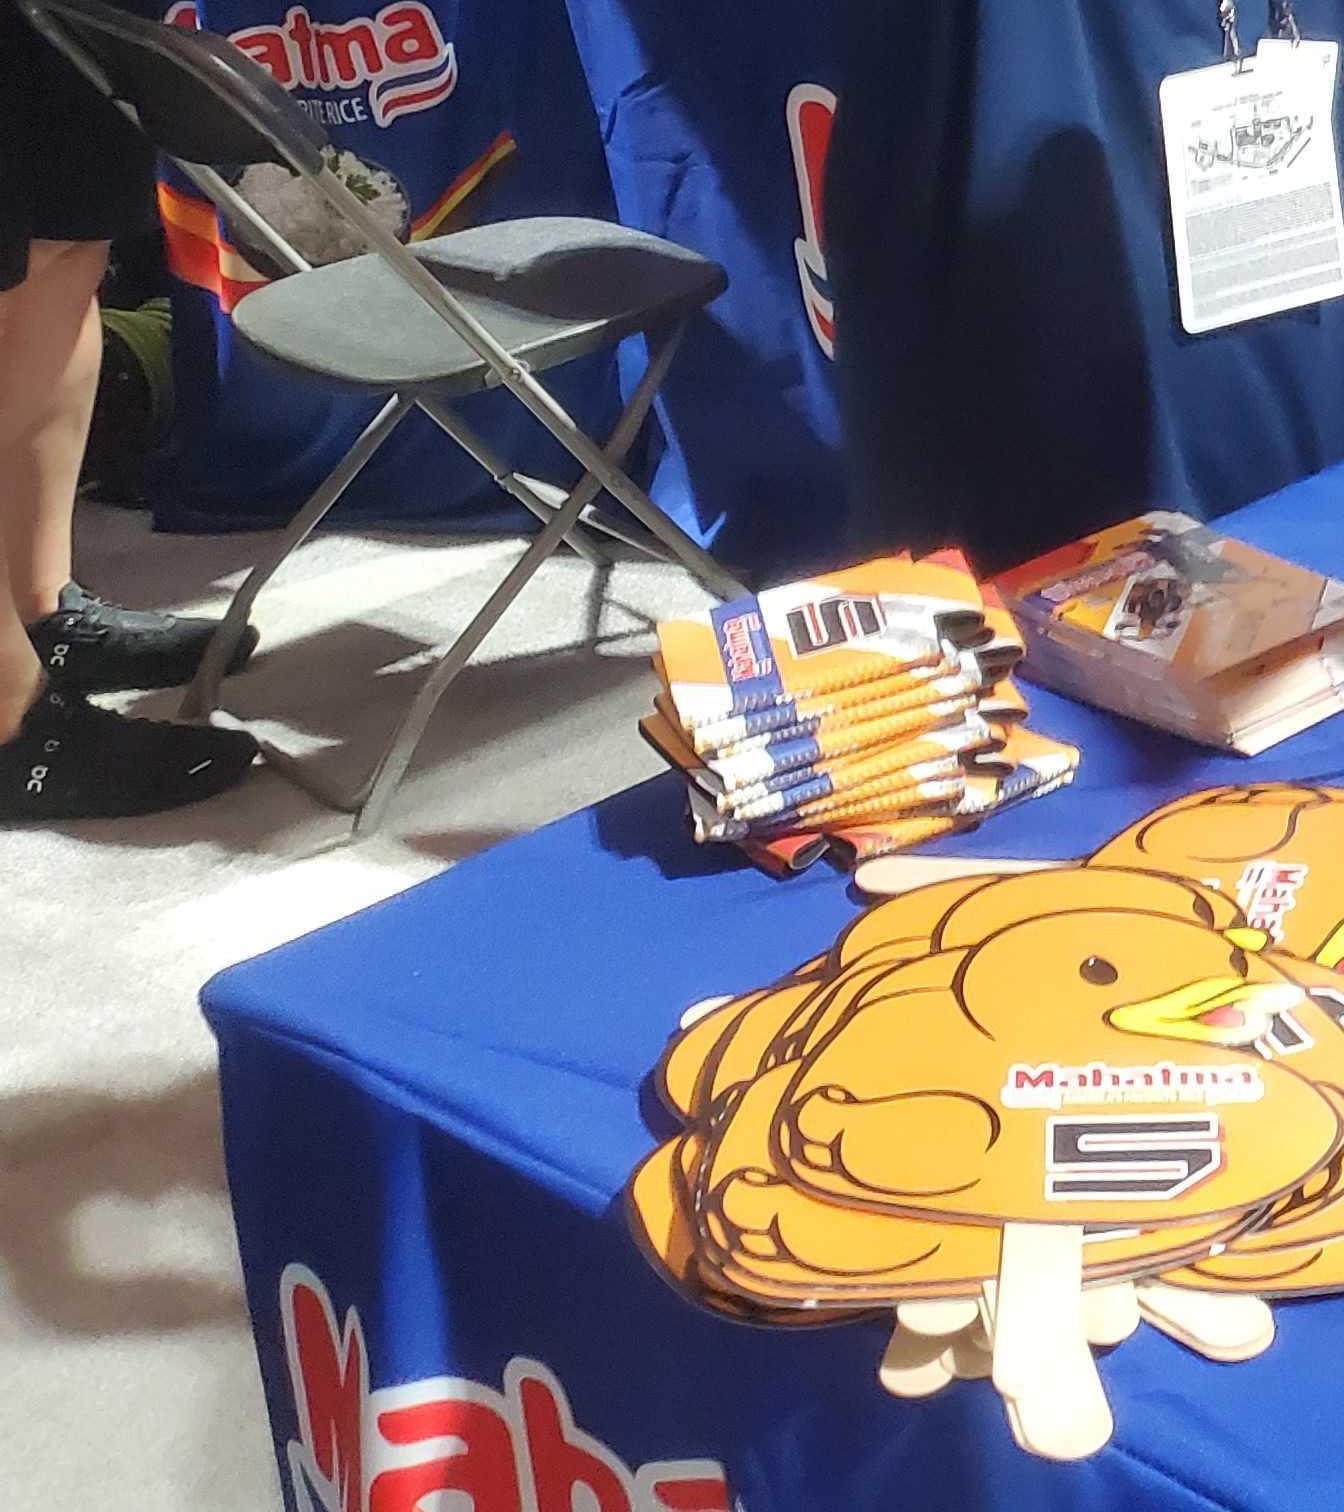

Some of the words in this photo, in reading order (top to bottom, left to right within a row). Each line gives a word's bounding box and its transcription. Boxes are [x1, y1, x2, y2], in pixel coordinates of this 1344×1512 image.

[327, 97, 369, 126] RICE
[786, 596, 888, 660] 5
[1013, 1067, 1254, 1090] Mahatma
[1048, 1116, 1222, 1199] 5
